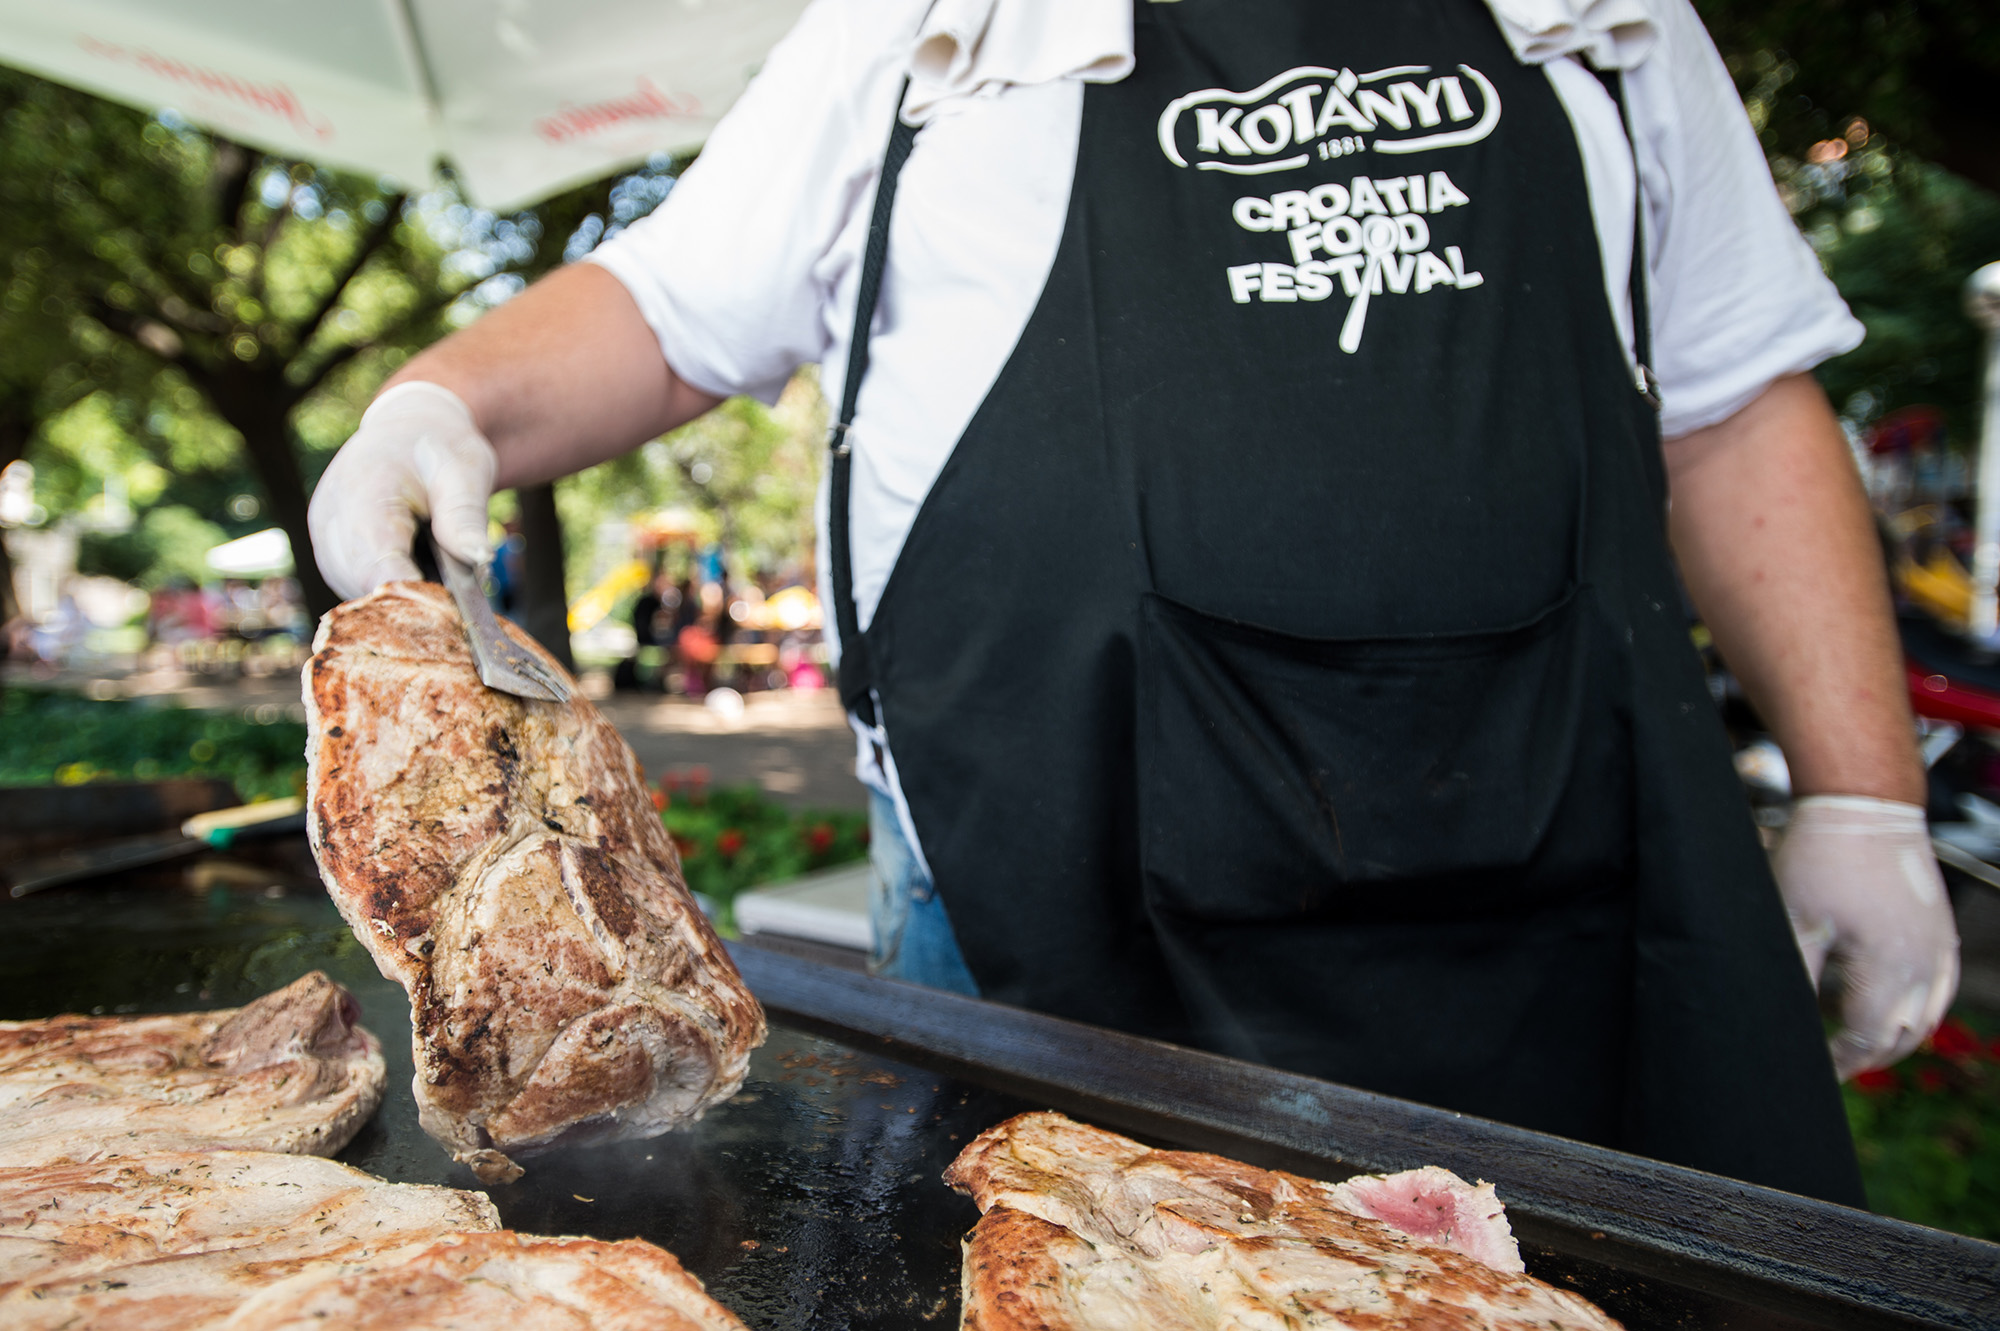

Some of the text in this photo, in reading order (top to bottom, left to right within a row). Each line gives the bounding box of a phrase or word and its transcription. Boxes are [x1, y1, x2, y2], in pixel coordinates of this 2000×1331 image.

[1317, 135, 1366, 161] 1881
[1232, 170, 1470, 232] CROATIA
[1287, 213, 1430, 265] FOOD
[1226, 246, 1484, 304] FESTIVAL
